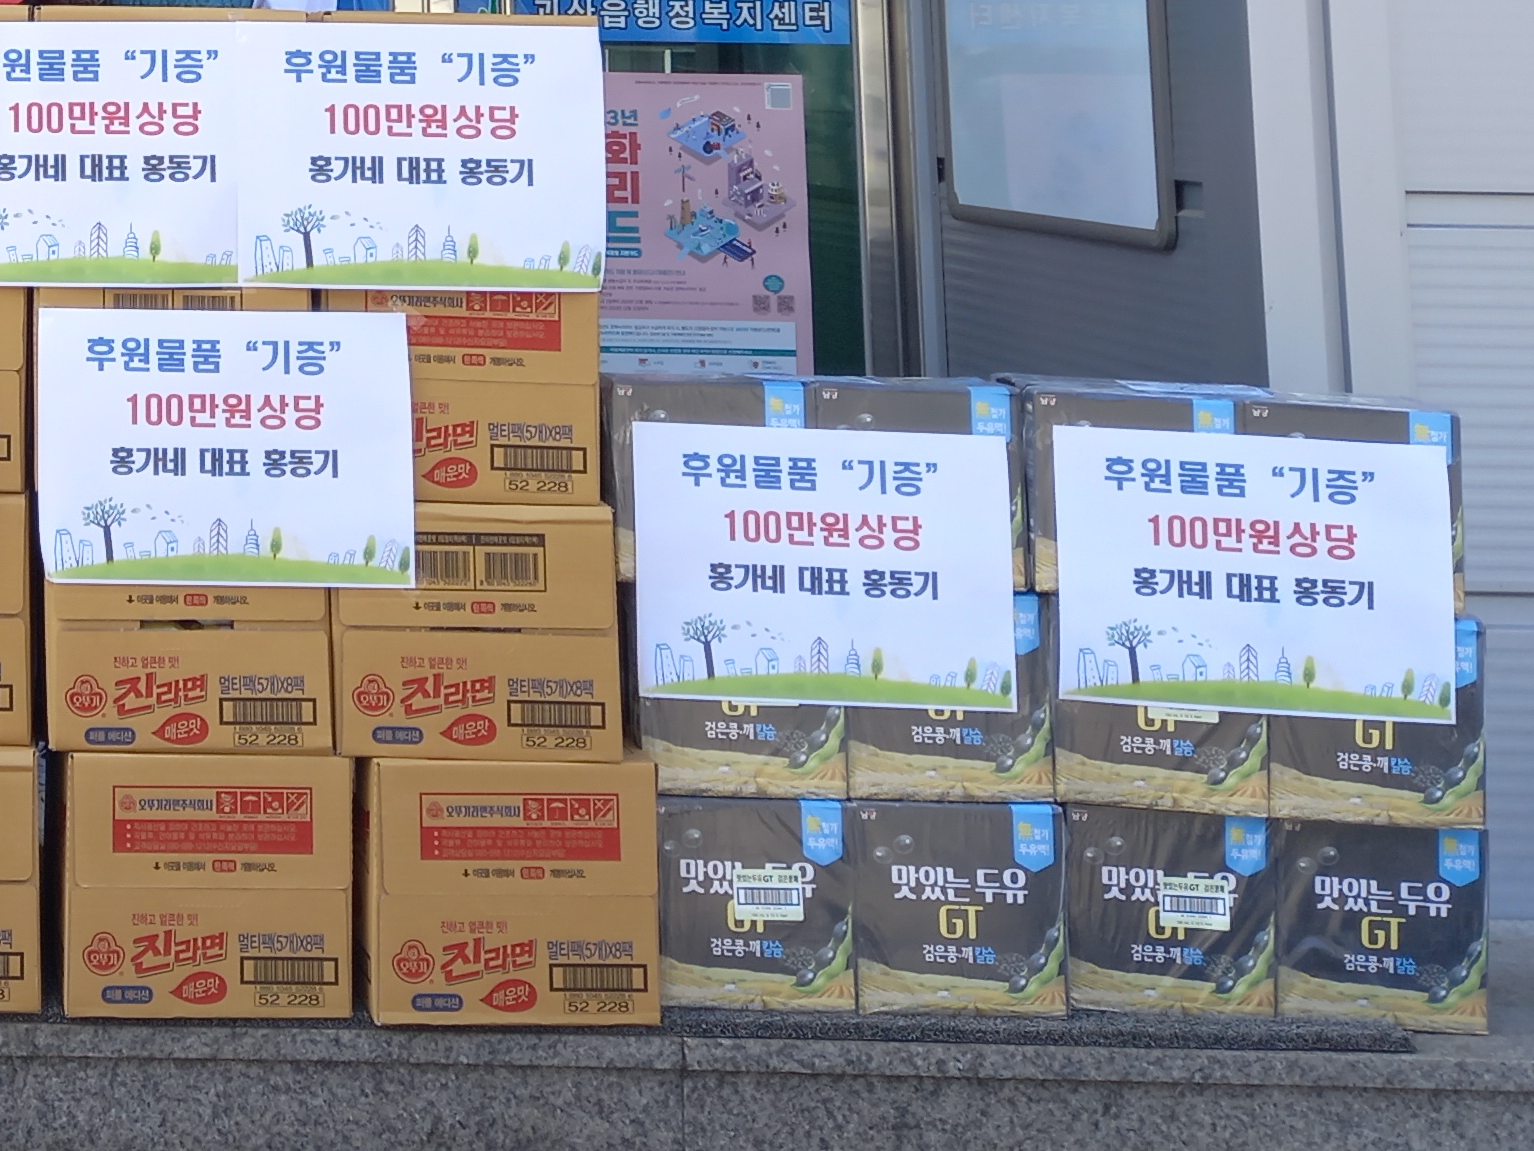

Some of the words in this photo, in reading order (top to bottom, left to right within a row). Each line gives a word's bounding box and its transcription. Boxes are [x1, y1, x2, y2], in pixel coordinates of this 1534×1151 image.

[284, 49, 417, 84] 후원물품
[8, 102, 202, 136] 100만원상당
[324, 104, 519, 139] 100만원상당
[79, 154, 129, 182] 대표
[142, 154, 216, 182] 홍동기
[308, 155, 383, 184] 홍가네
[397, 156, 447, 184] 대표
[459, 158, 534, 186] 홍동기
[86, 337, 221, 373] 후원물품
[126, 393, 324, 430] 100만원상당
[109, 447, 186, 476] 홍가네
[199, 448, 250, 477] 대표
[262, 448, 339, 479] 홍동기
[681, 452, 817, 492] 후원물품
[1104, 456, 1246, 498] 후원물품
[724, 510, 922, 551] 100만원상당
[1148, 514, 1358, 560] 100만원상당
[708, 563, 785, 593] 홍가네
[798, 566, 850, 596] 대표
[862, 569, 939, 600] 홍동기
[1133, 567, 1212, 600] 홍가네
[1226, 572, 1280, 604] 대표
[1293, 577, 1375, 610] 홍동기
[112, 673, 208, 718] 진라면
[400, 673, 496, 718] 진라면
[939, 904, 984, 940] GT
[1361, 915, 1407, 951] GT
[130, 929, 228, 977] 진라면
[440, 937, 537, 985] 진라면
[181, 977, 220, 1000] 매운맛
[567, 1000, 590, 1013] 52
[597, 1000, 629, 1013] 228
